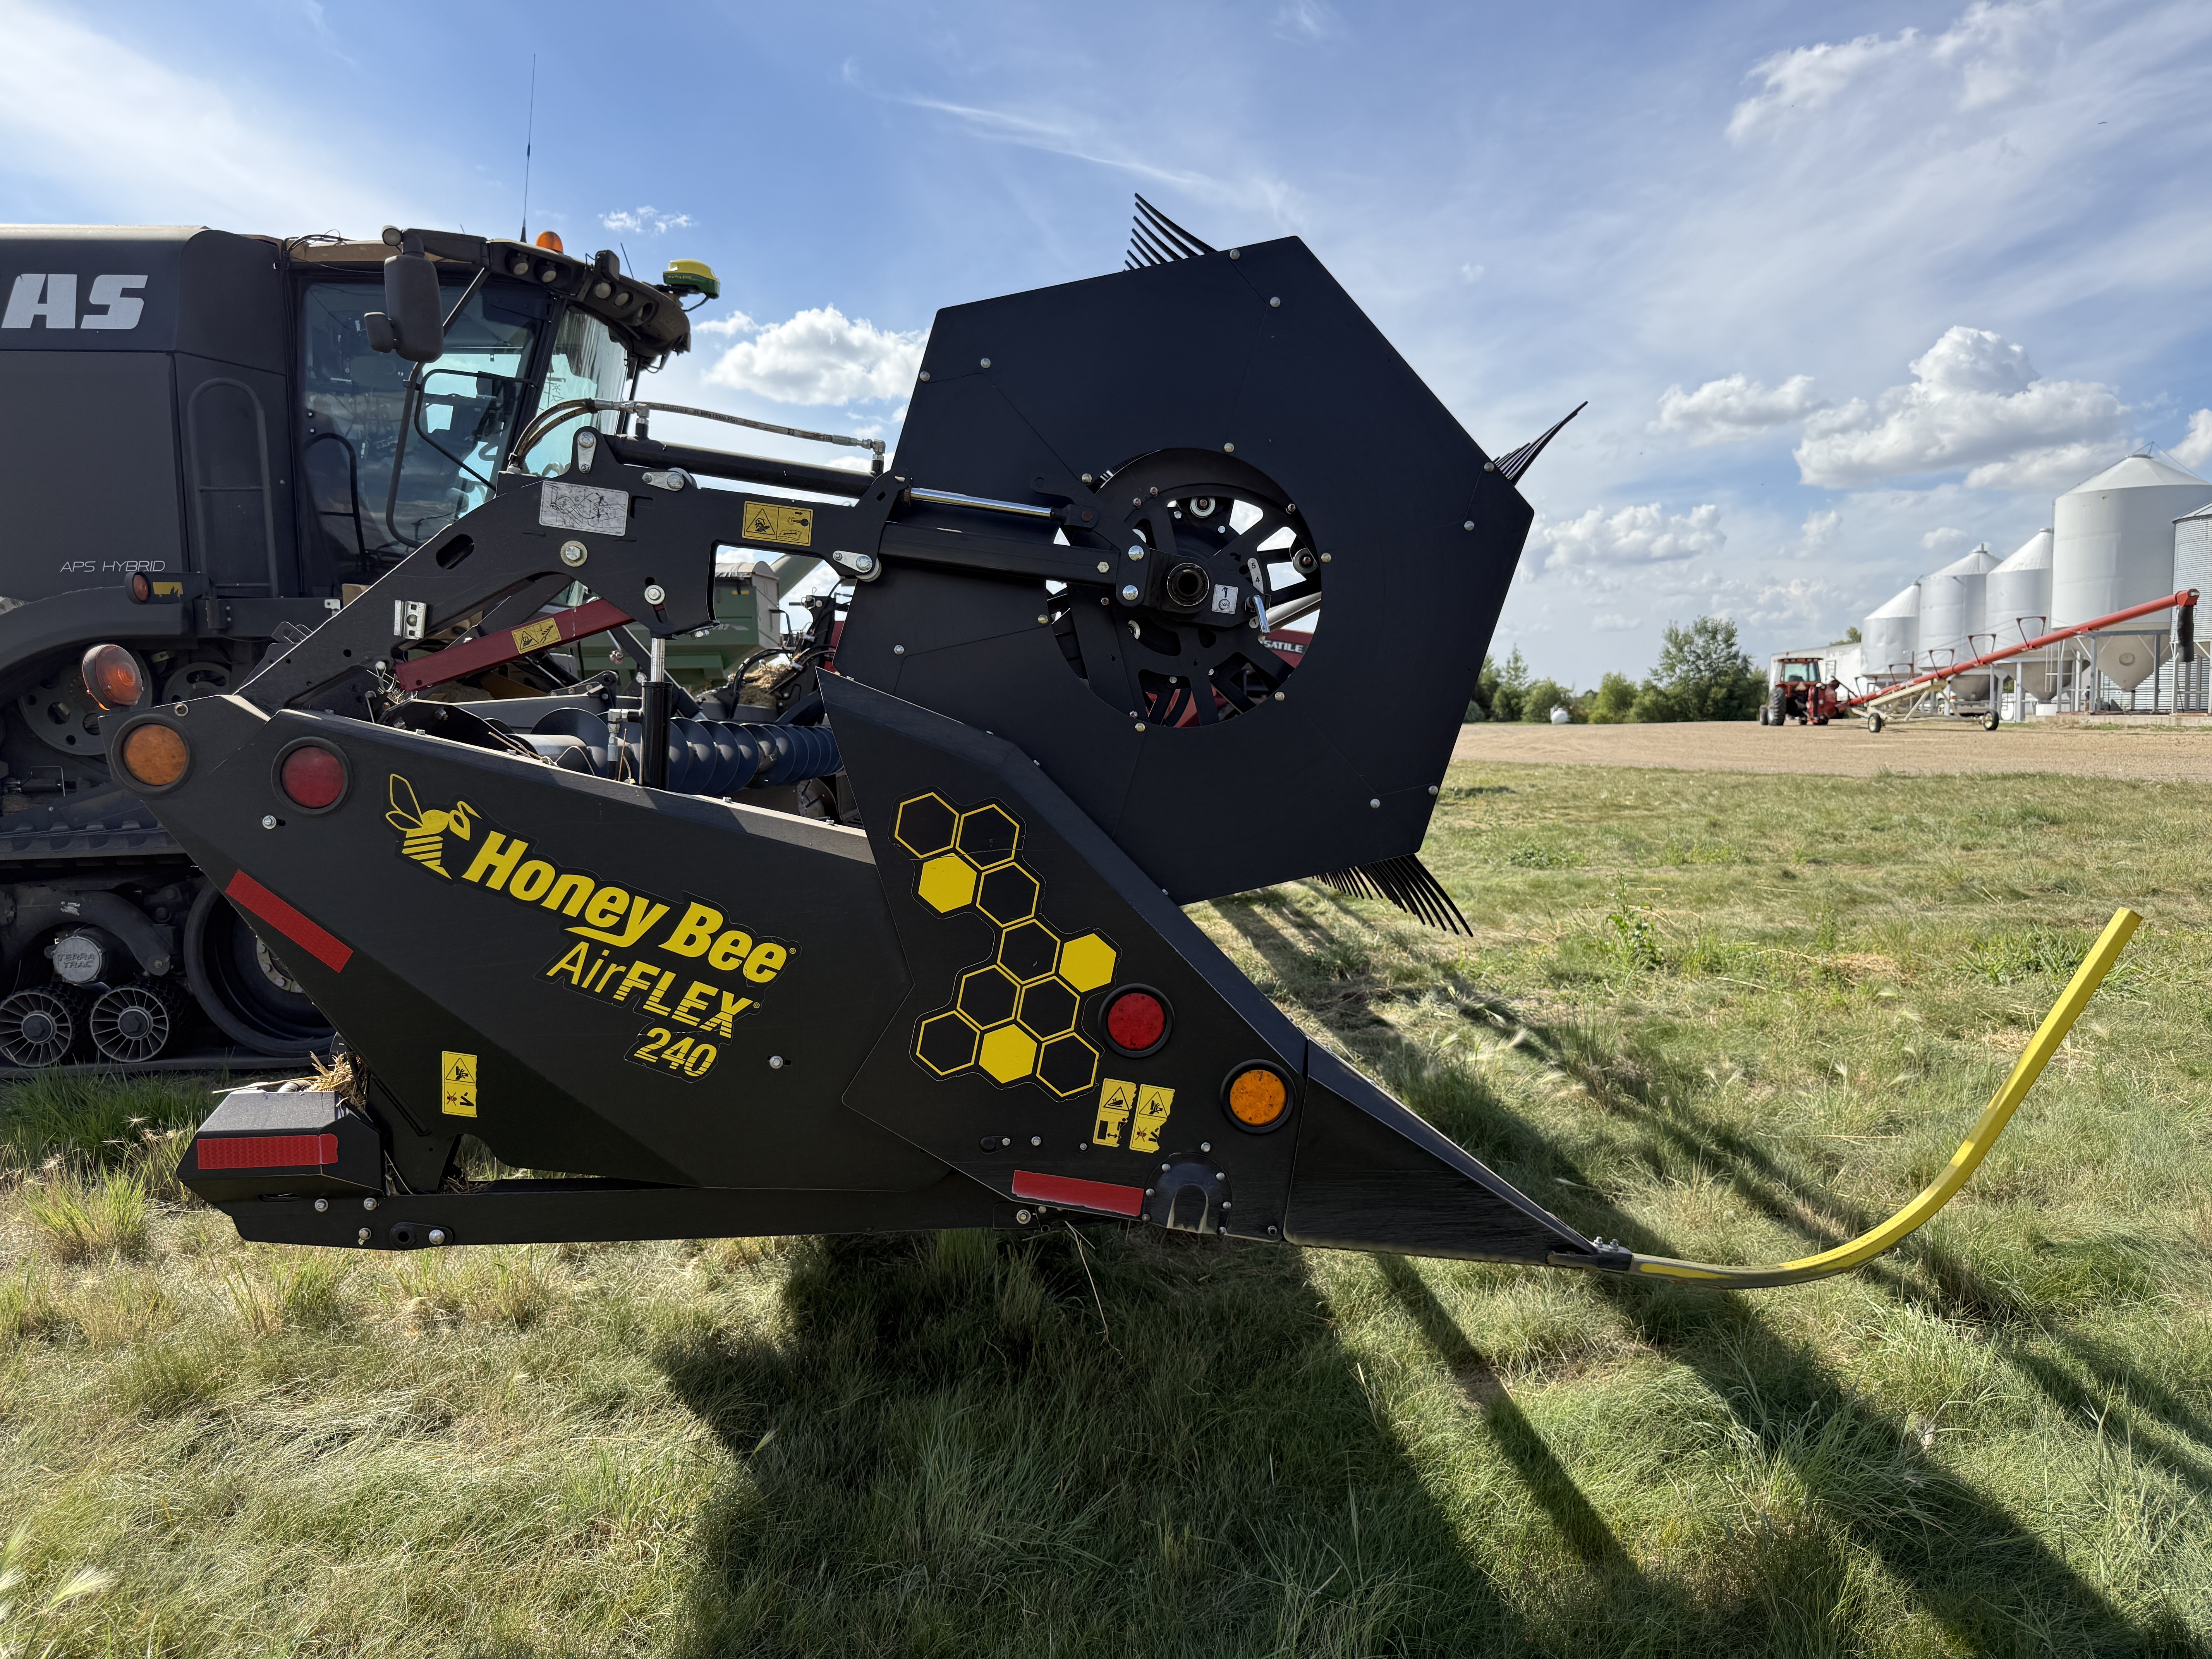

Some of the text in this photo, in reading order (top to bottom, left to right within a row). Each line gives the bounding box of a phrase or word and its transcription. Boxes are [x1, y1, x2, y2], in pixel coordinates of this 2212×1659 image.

[2, 274, 148, 329] AS
[60, 561, 165, 572] APS HYBRID
[462, 831, 670, 948] Honey
[58, 953, 95, 961] TERRA
[635, 1027, 717, 1077] 240
